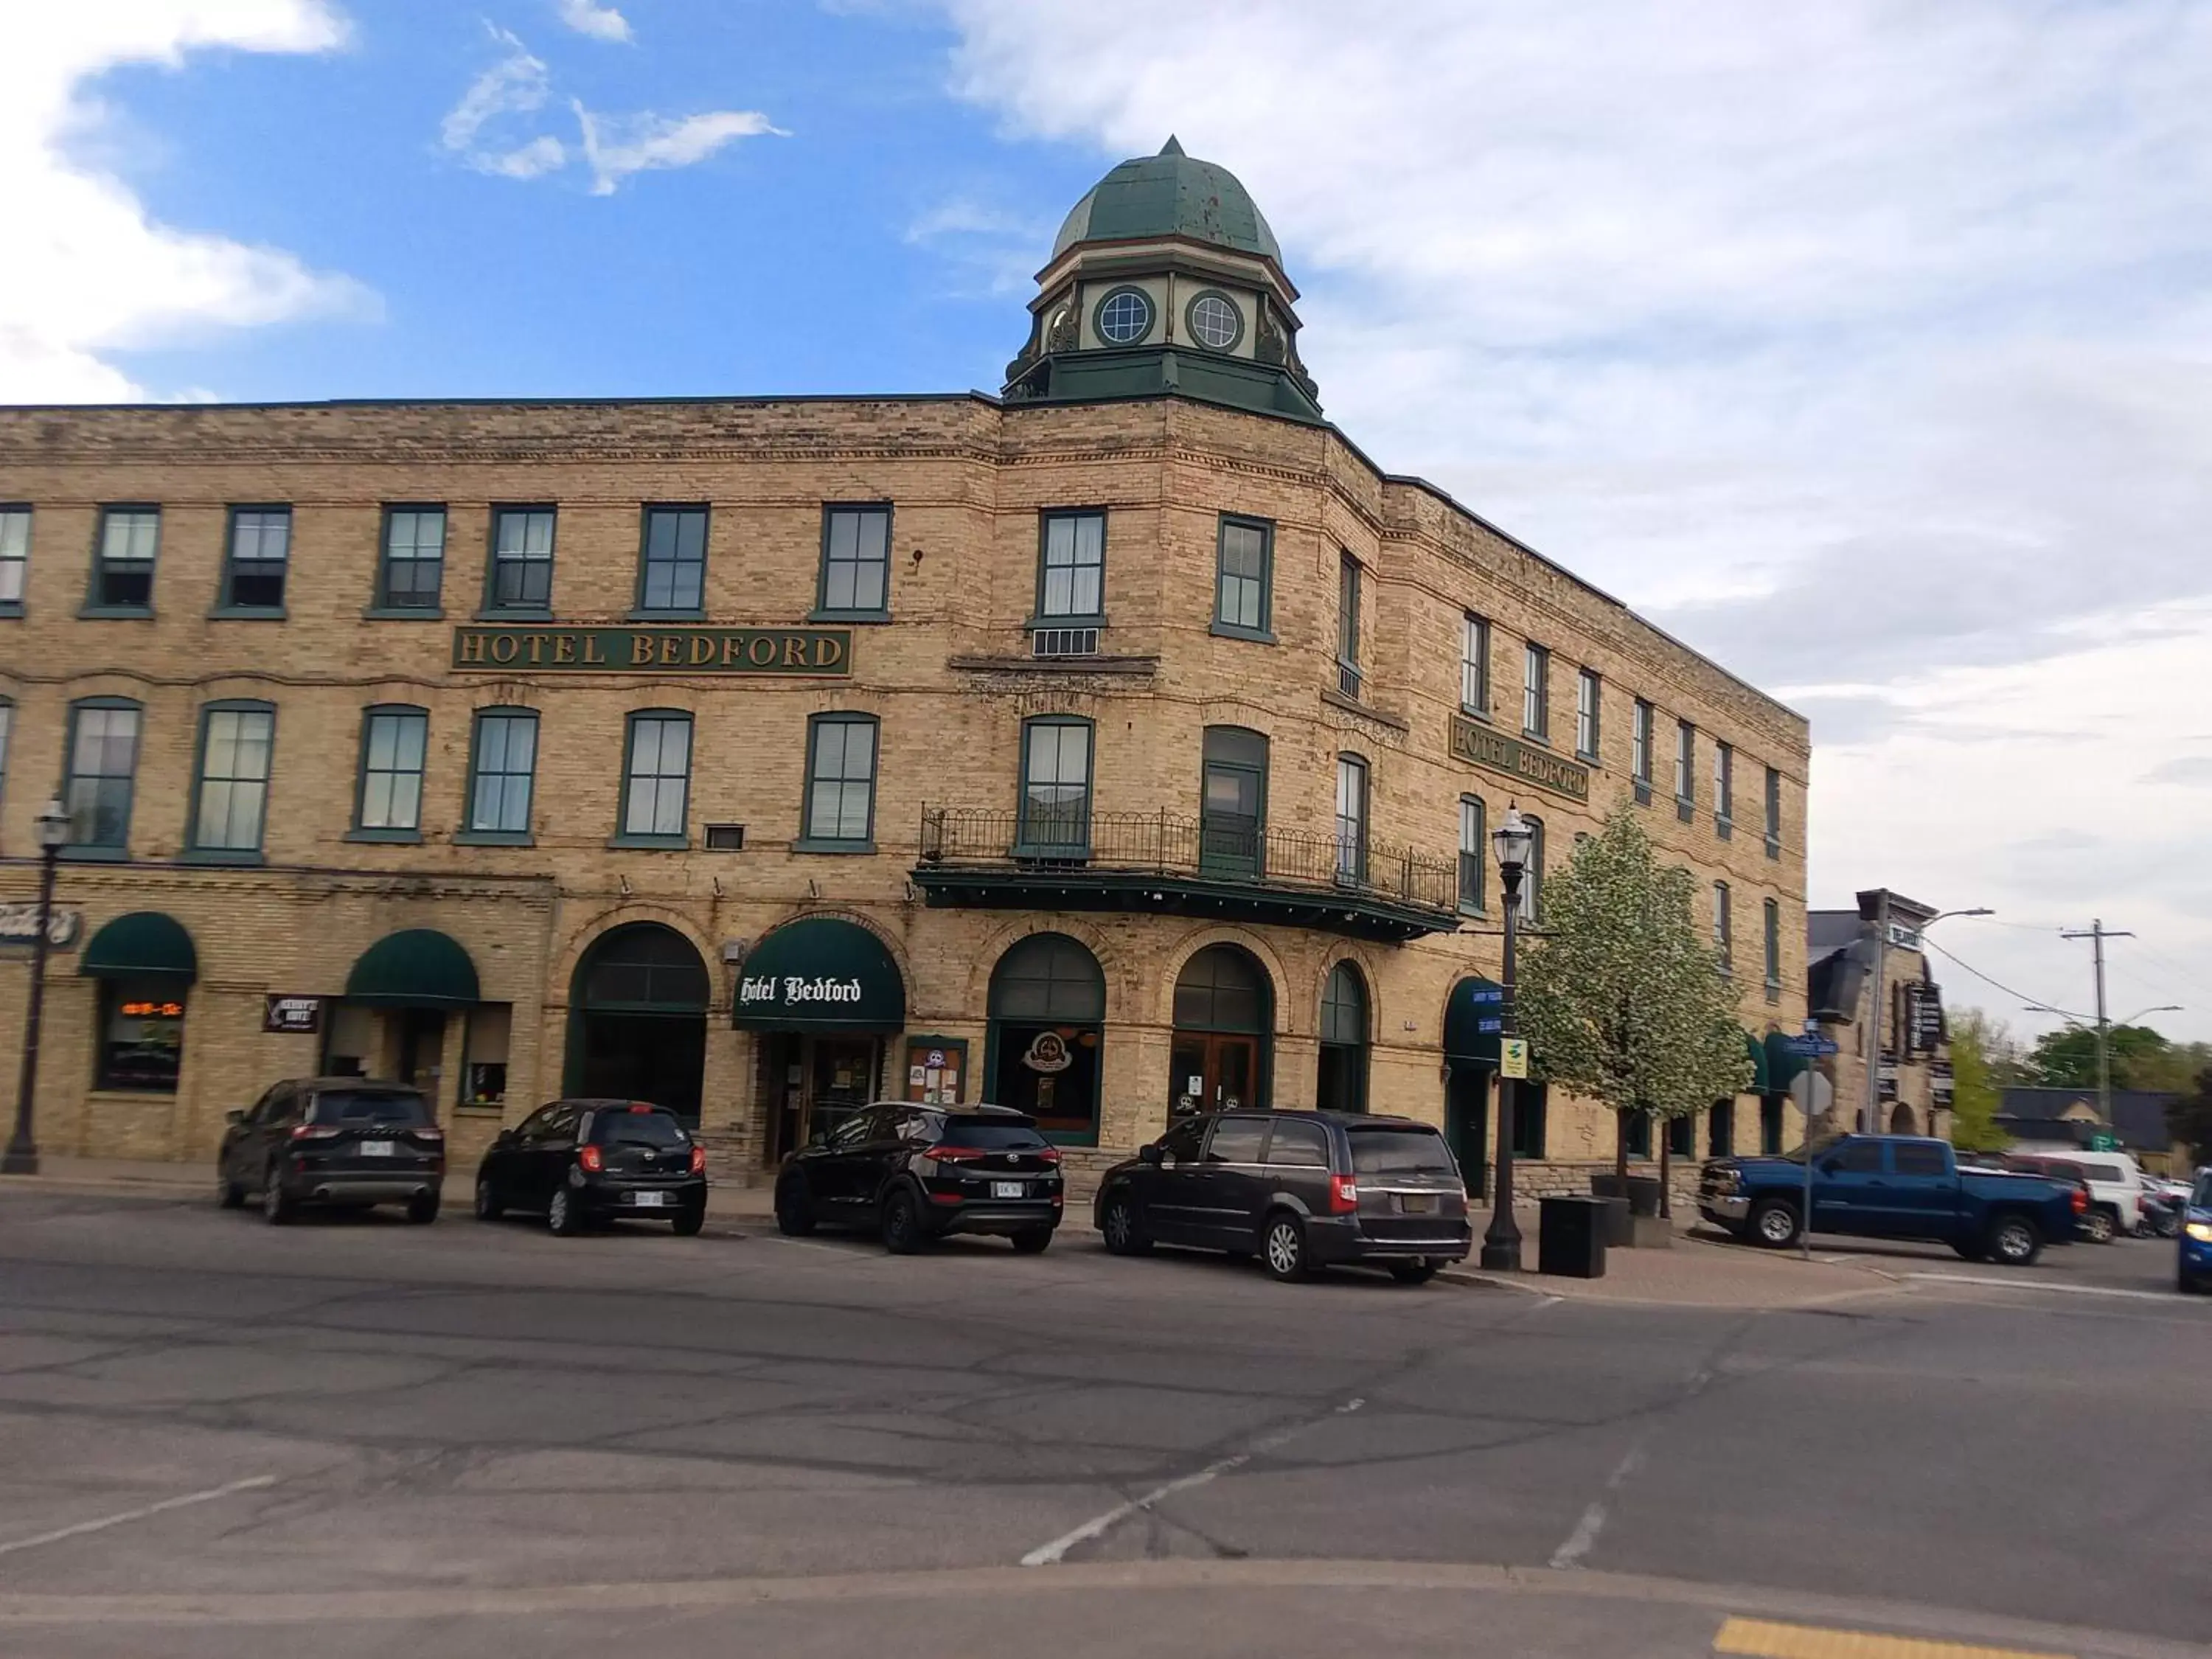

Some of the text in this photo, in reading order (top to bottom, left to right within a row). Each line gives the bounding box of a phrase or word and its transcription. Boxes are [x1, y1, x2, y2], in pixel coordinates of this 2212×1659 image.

[459, 634, 842, 667] HOTEL BEDFORD
[1453, 723, 1586, 795] HOTEL BEDFORD
[740, 975, 860, 1006] Hotel Bedford
